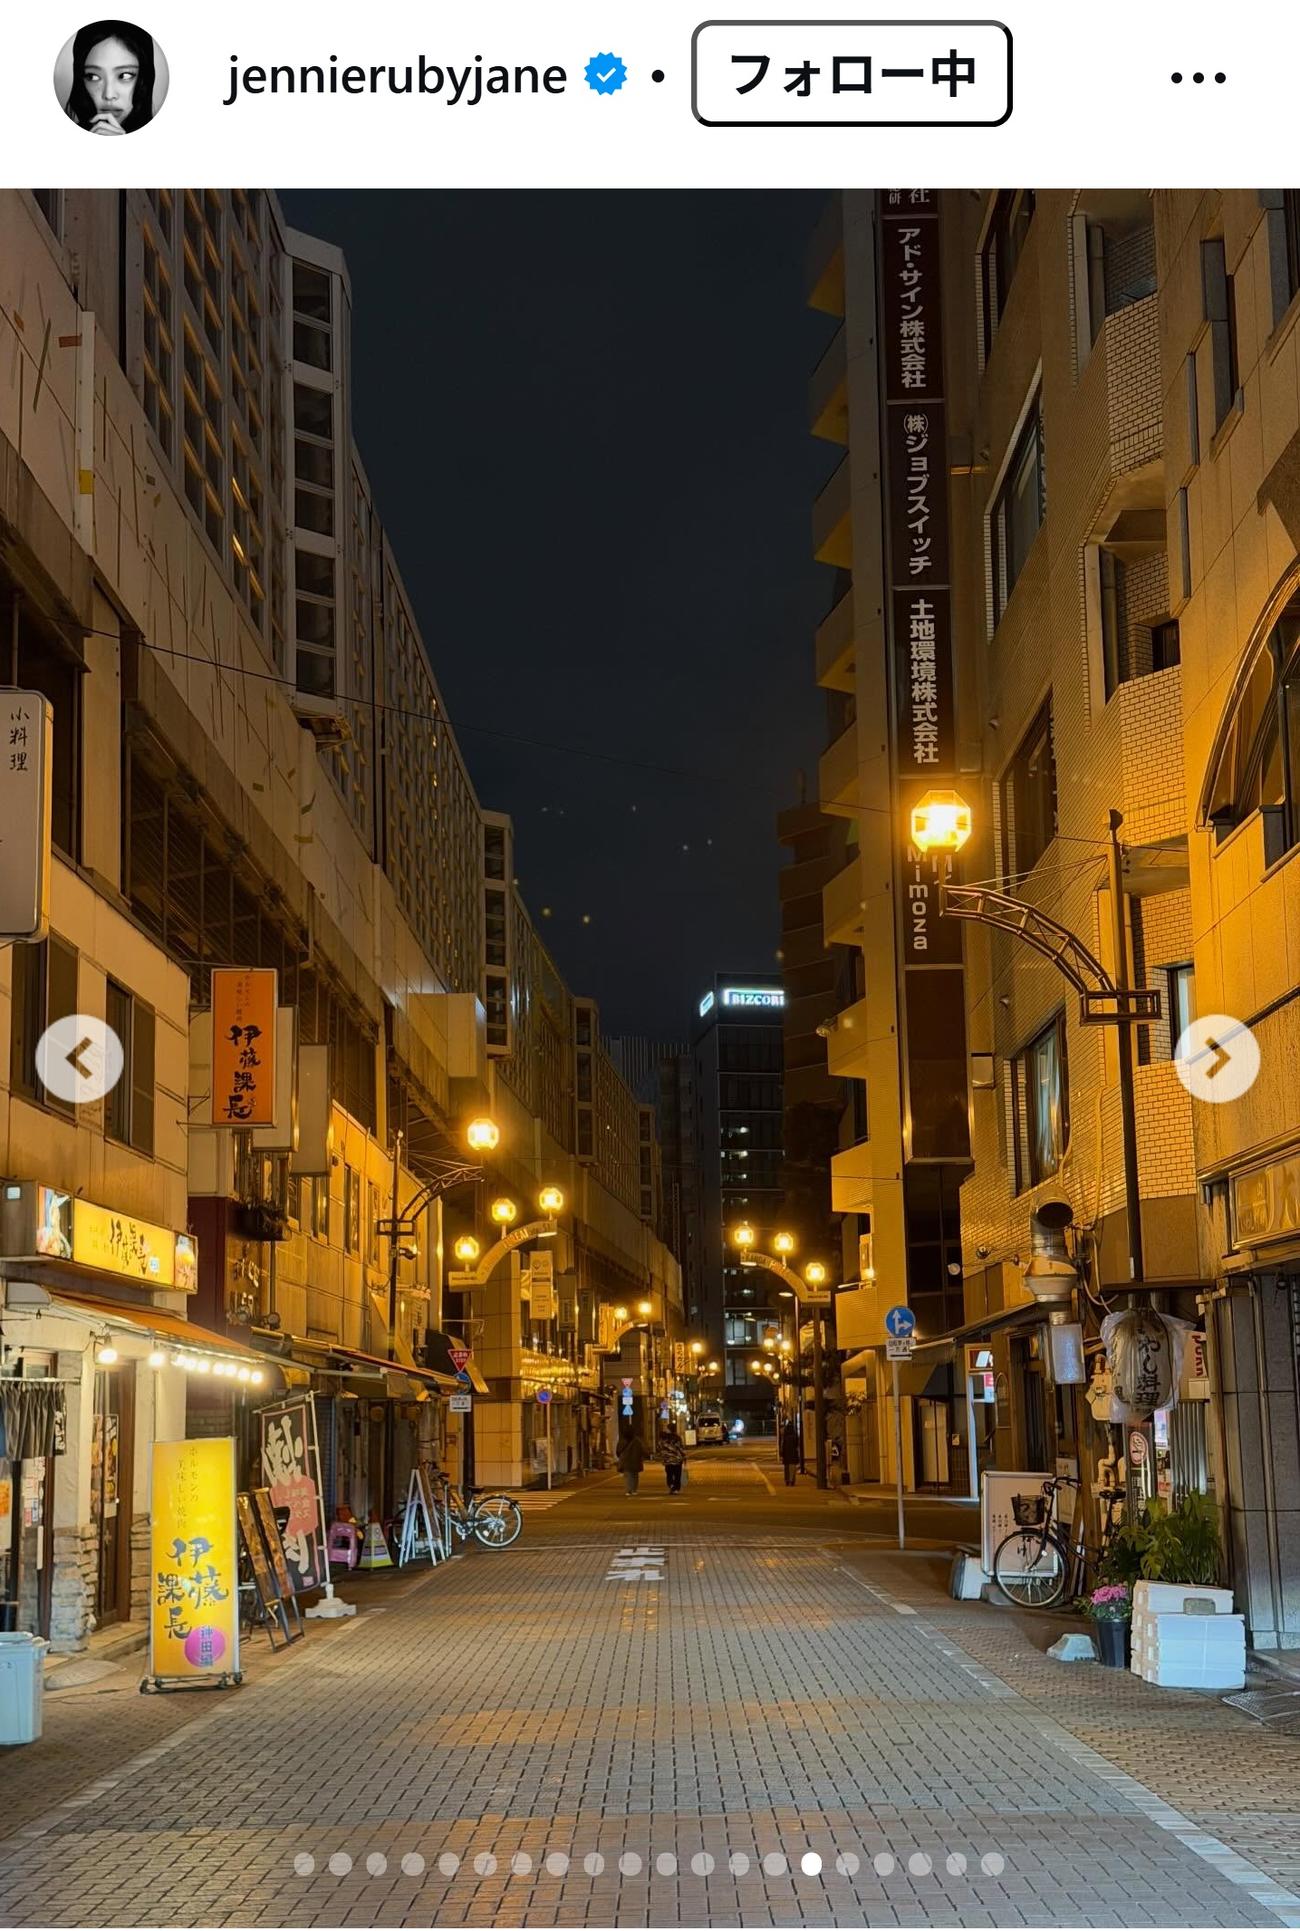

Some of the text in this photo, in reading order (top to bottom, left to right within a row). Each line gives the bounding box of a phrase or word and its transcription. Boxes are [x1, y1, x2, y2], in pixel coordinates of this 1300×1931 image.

[898, 228, 926, 388] アド・サイン株式会社
[9, 706, 30, 771] 小料理
[909, 599, 939, 764] 土地環境株式会社
[907, 846, 929, 950] Mimoza
